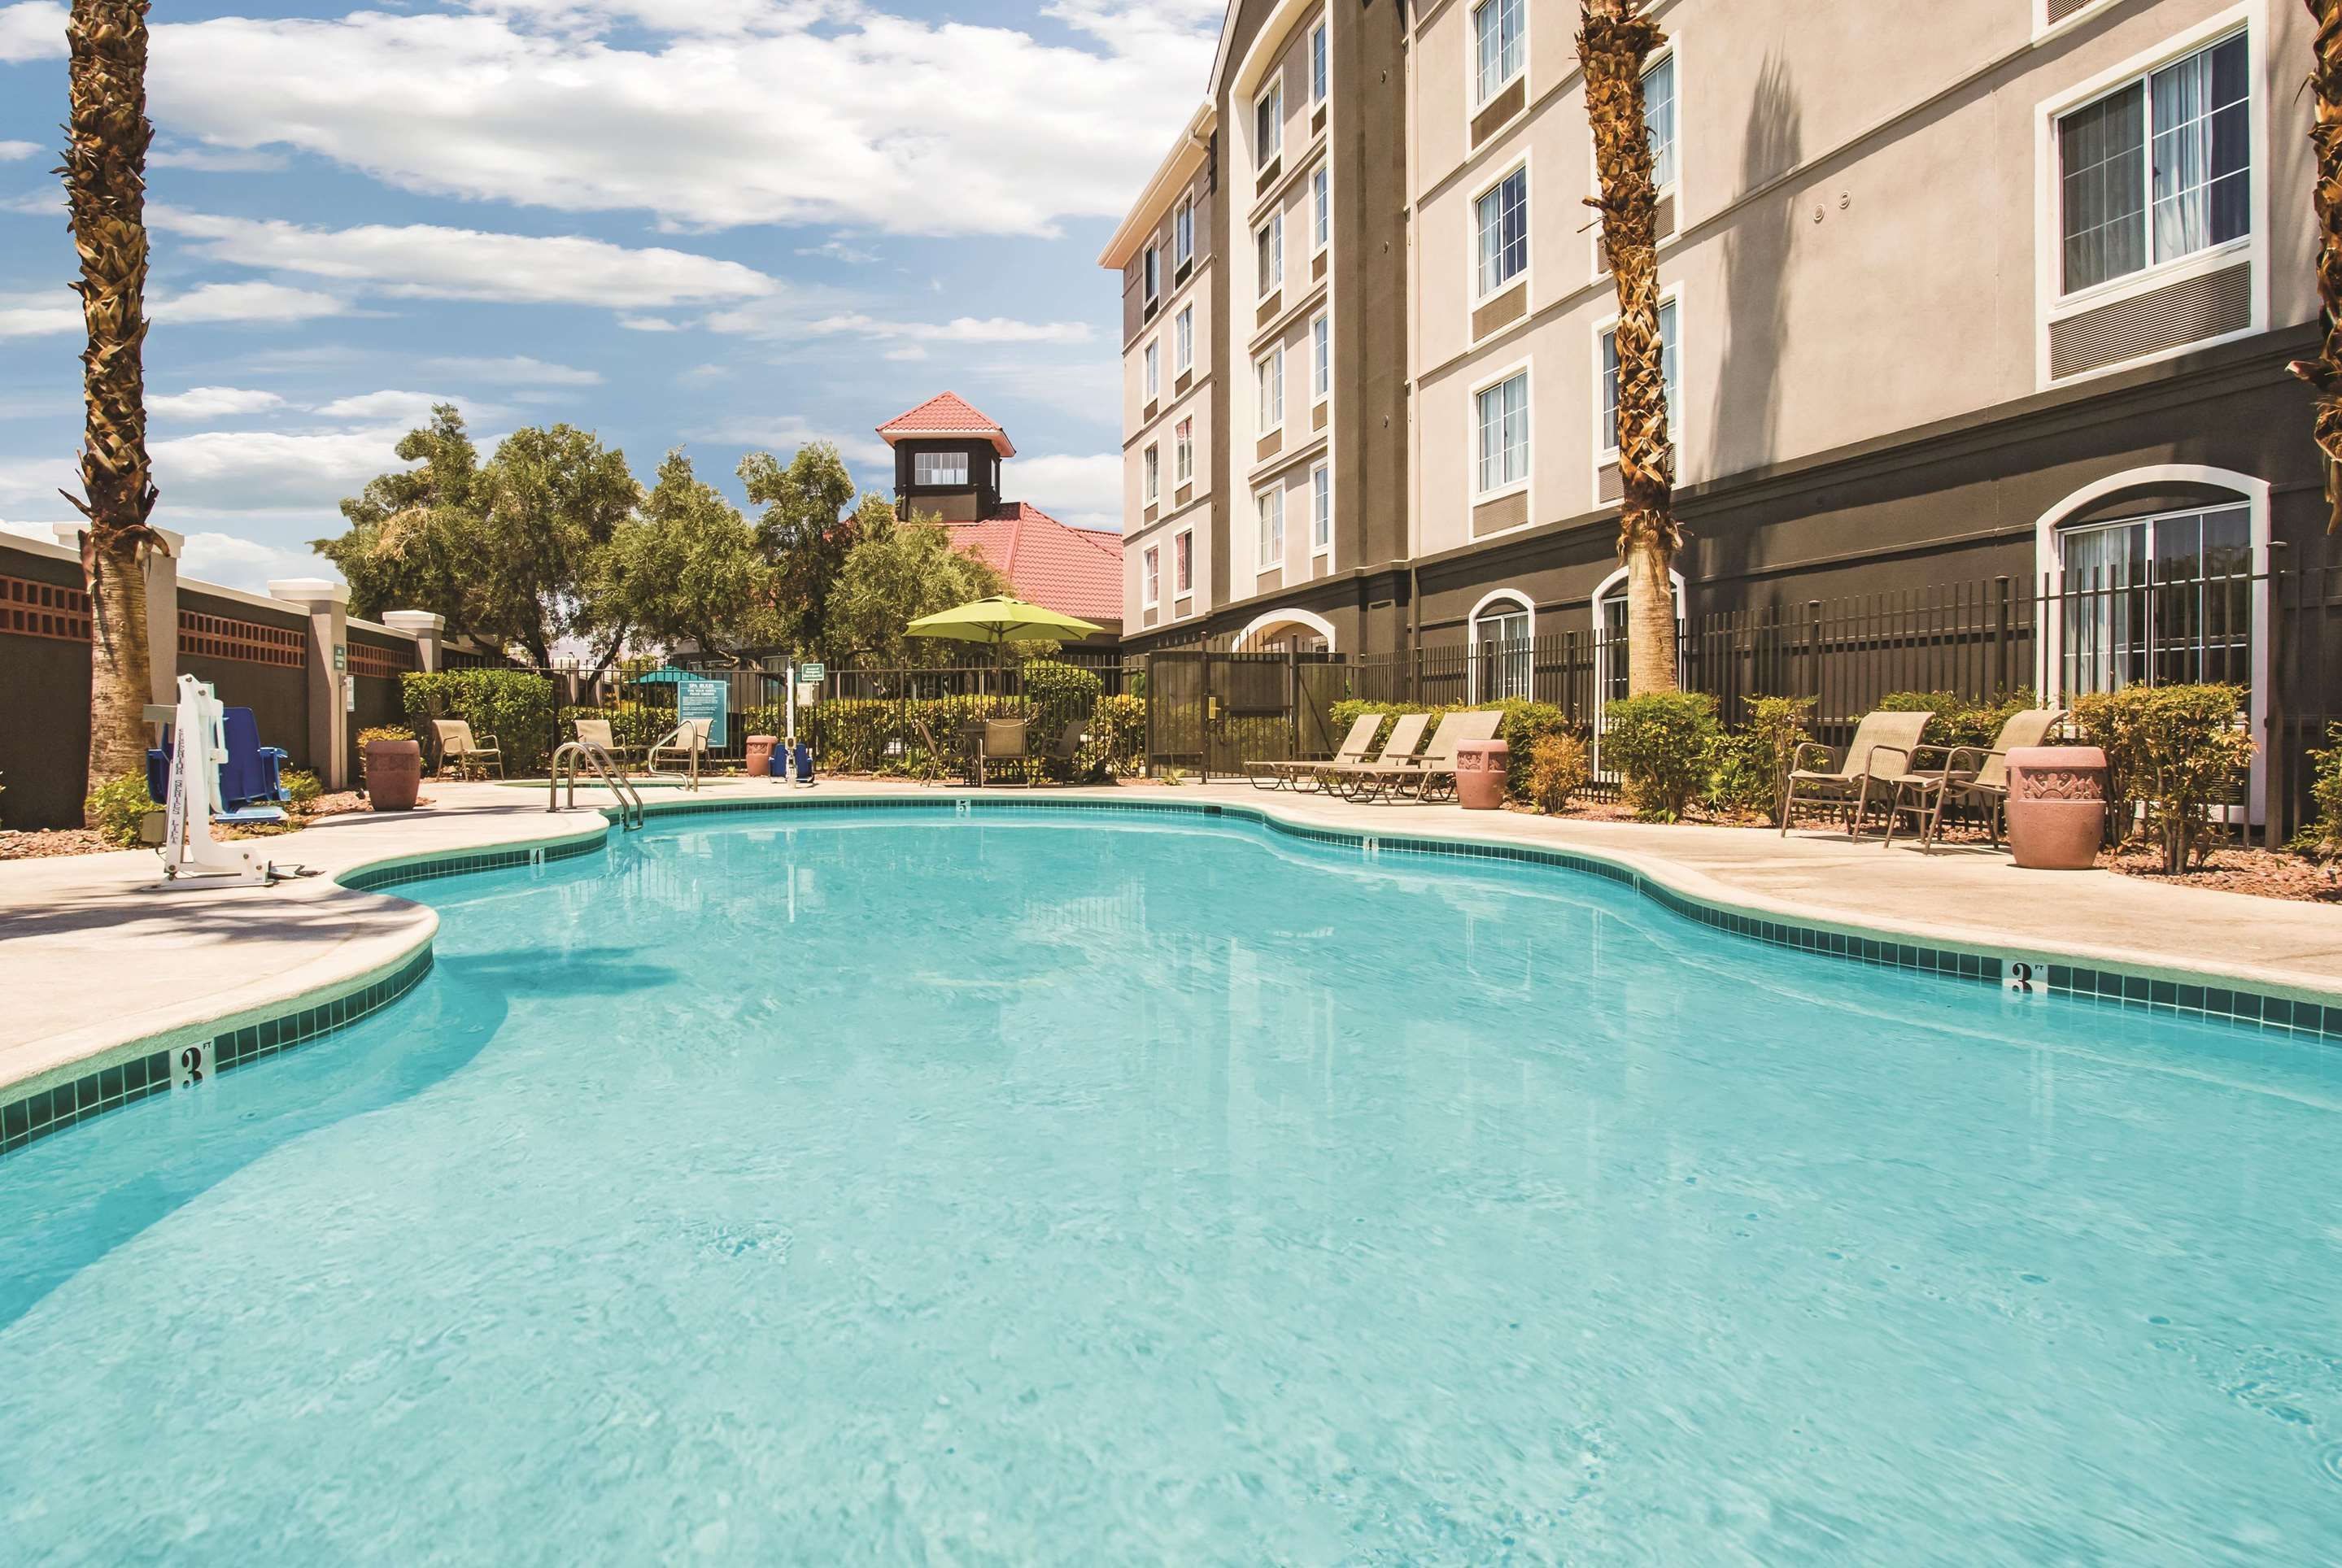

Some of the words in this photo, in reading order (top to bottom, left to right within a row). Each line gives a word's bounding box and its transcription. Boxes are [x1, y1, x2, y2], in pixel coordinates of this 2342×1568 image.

[532, 849, 540, 865] 4
[2011, 962, 2033, 994] 3
[181, 1047, 203, 1089] 3
[203, 1041, 212, 1050] FT
